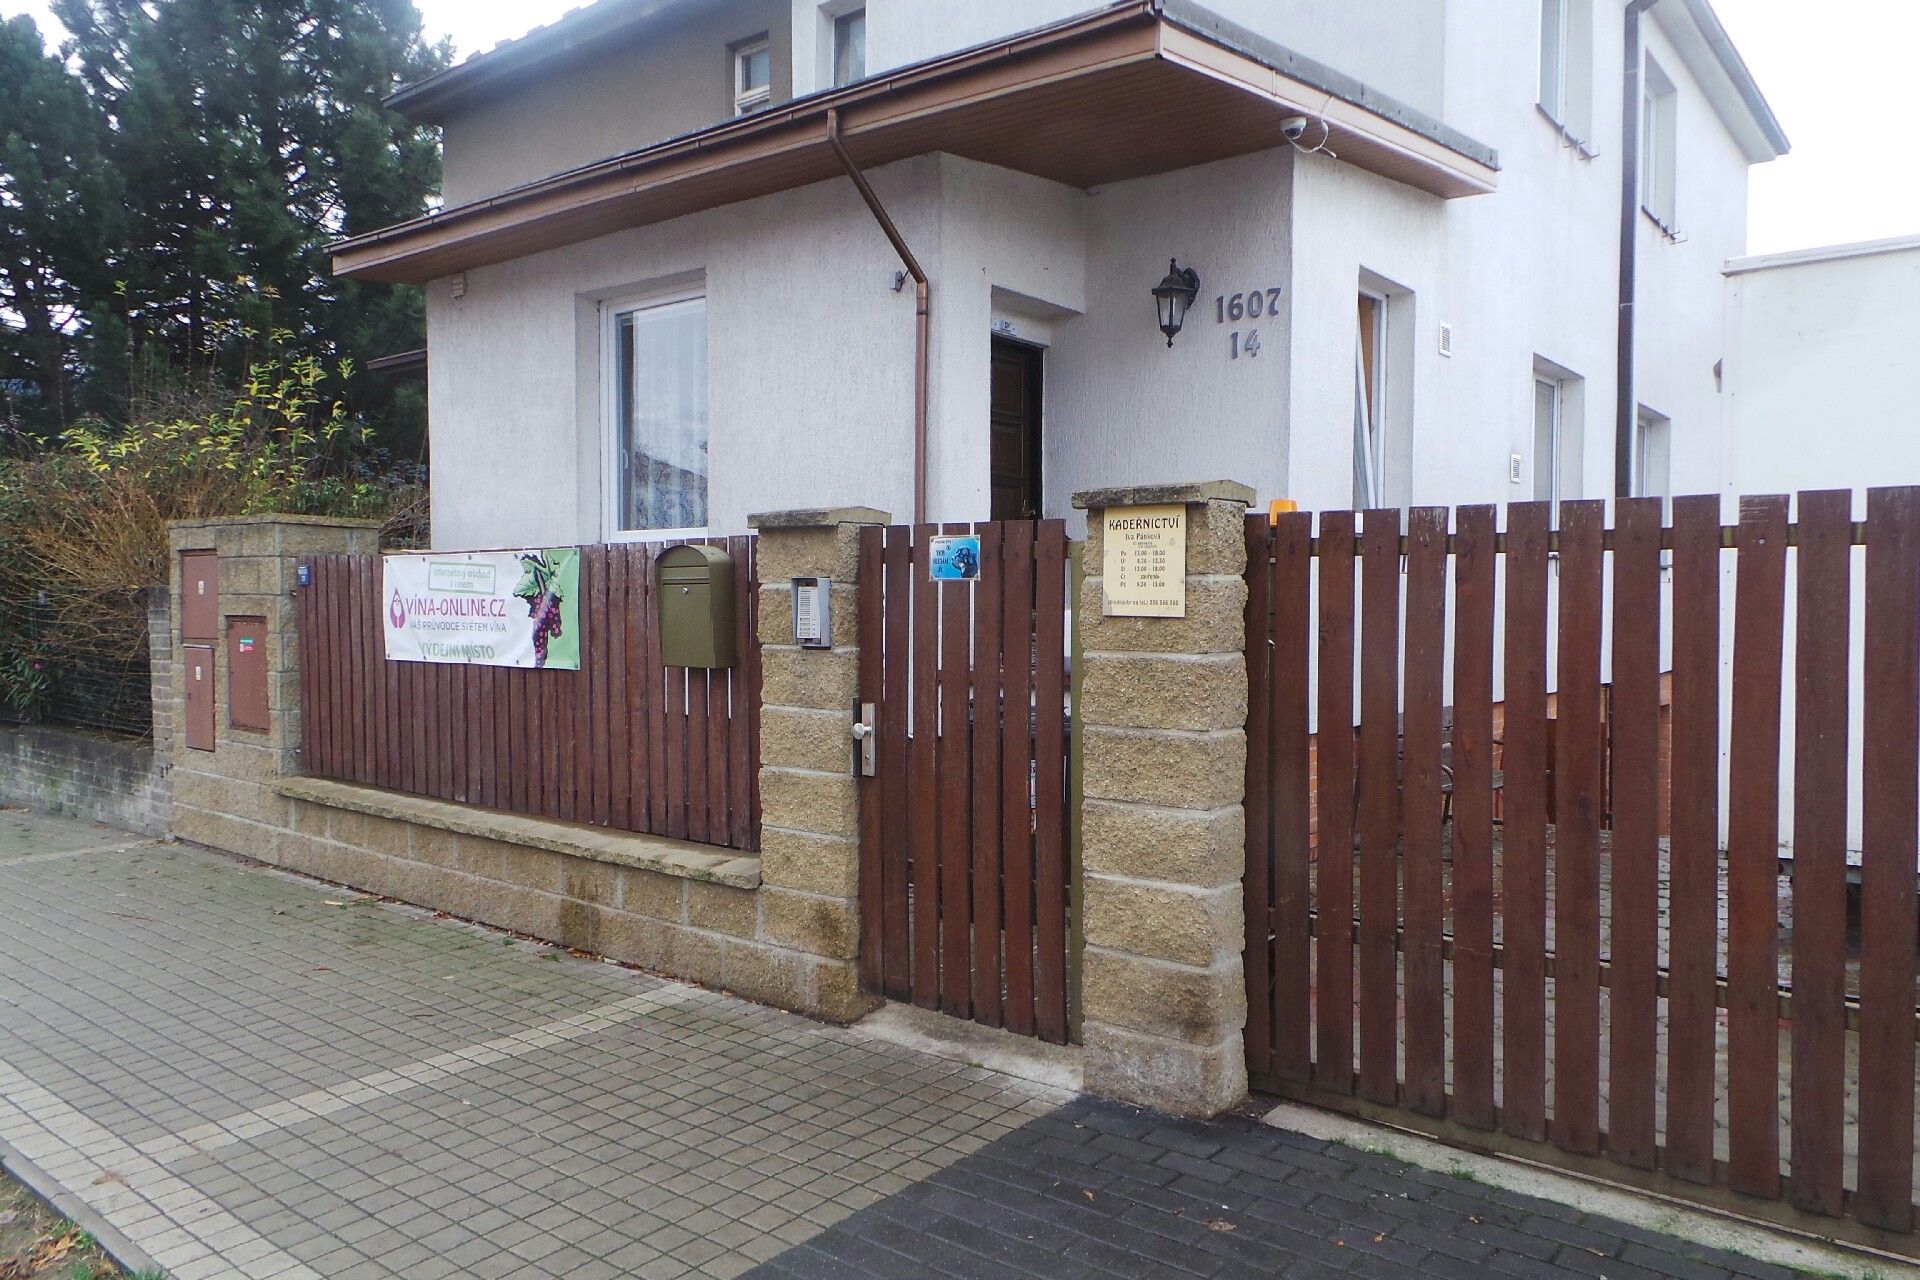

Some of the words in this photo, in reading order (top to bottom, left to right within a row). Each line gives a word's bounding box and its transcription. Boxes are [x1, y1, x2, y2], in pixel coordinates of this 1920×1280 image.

[1216, 287, 1282, 324] 1607
[1231, 329, 1261, 360] 14
[1109, 514, 1180, 530] KADEŘNICTVÍ
[405, 593, 507, 618] VÍNA-ONLINE.CZ
[409, 618, 421, 630] VÁŠ
[422, 618, 460, 631] PRŮVODCE
[460, 620, 488, 632] SVĚTEM
[418, 639, 460, 658] VÝDEJNÍ
[460, 641, 495, 660] MÍSTO
